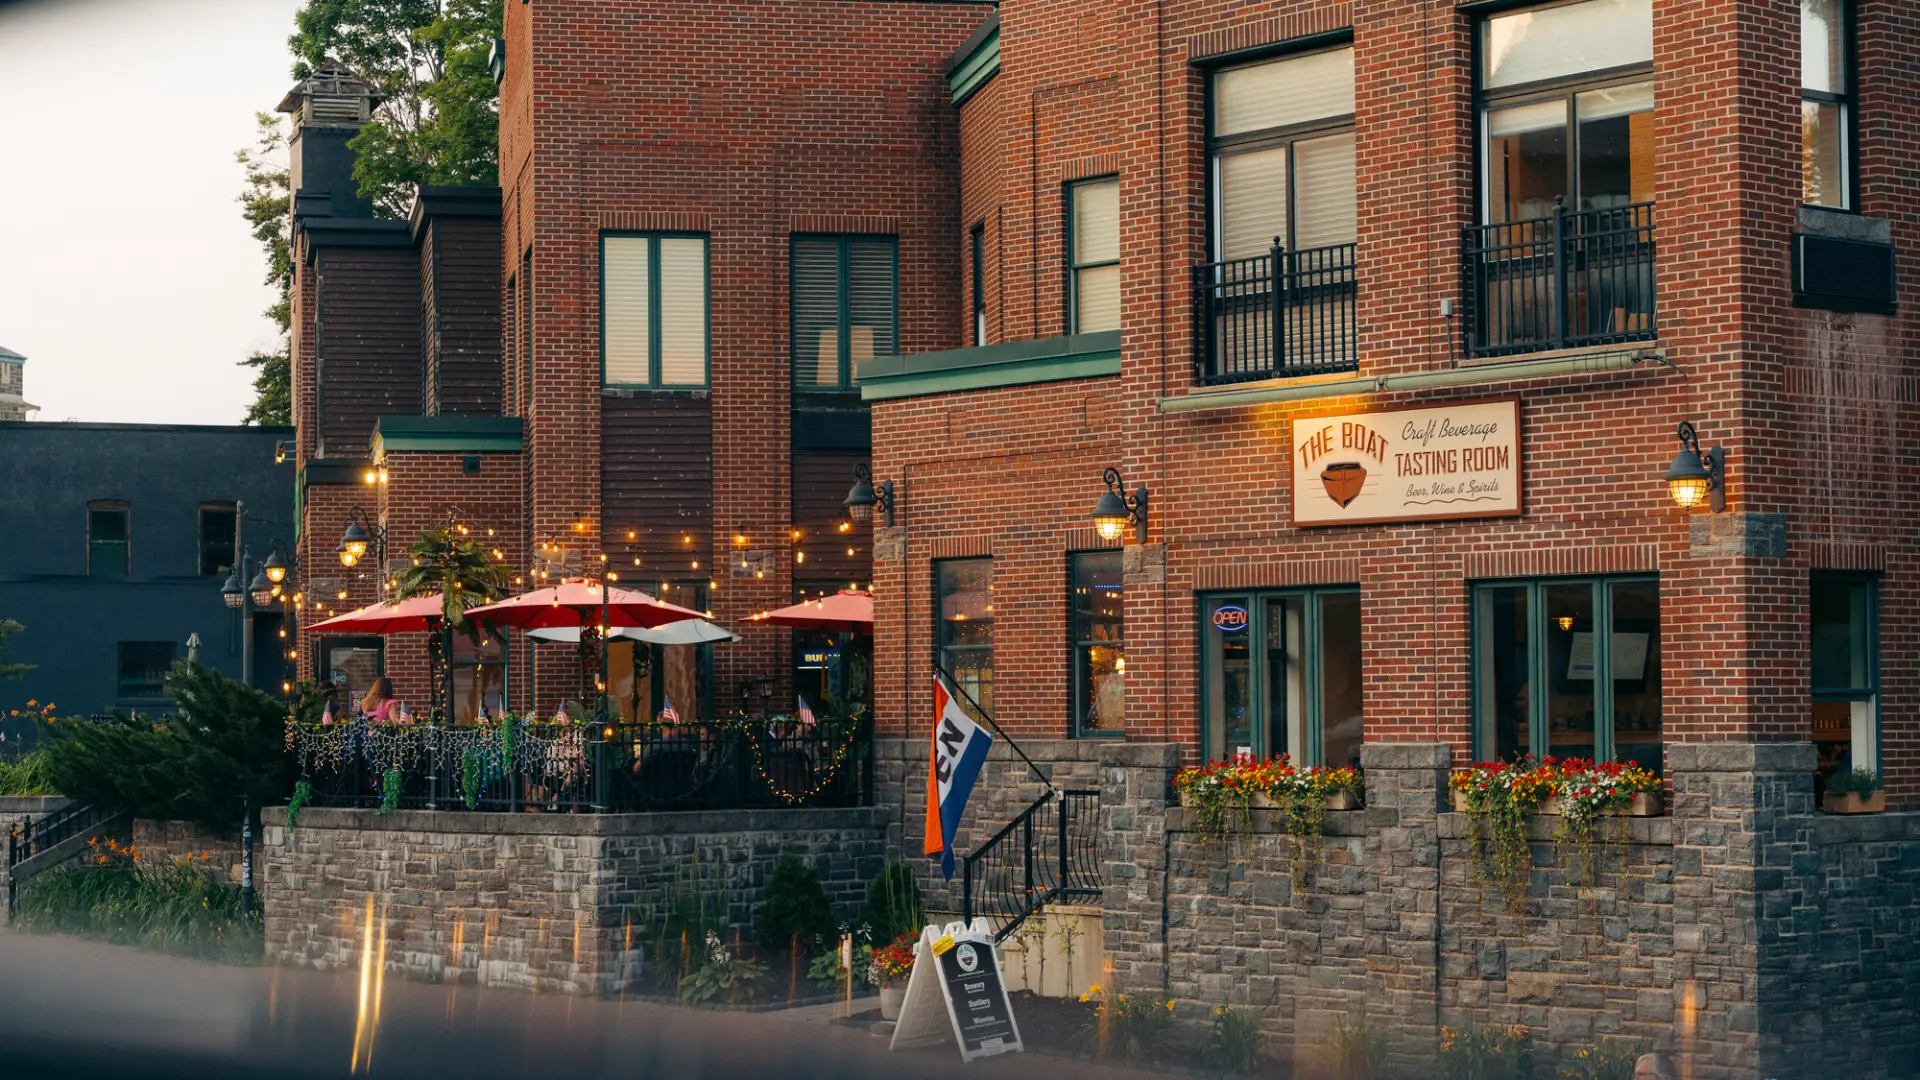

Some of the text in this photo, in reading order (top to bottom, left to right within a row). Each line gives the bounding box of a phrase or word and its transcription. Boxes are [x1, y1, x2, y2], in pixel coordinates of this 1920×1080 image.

[1401, 418, 1498, 447] Craft Beverage
[1299, 422, 1389, 469] THE BOAT
[1394, 445, 1509, 478] TASTING ROOM
[1405, 478, 1500, 497] Beer, Wine & Spirits
[1212, 611, 1248, 625] OPEN
[964, 982, 984, 990] Brewery
